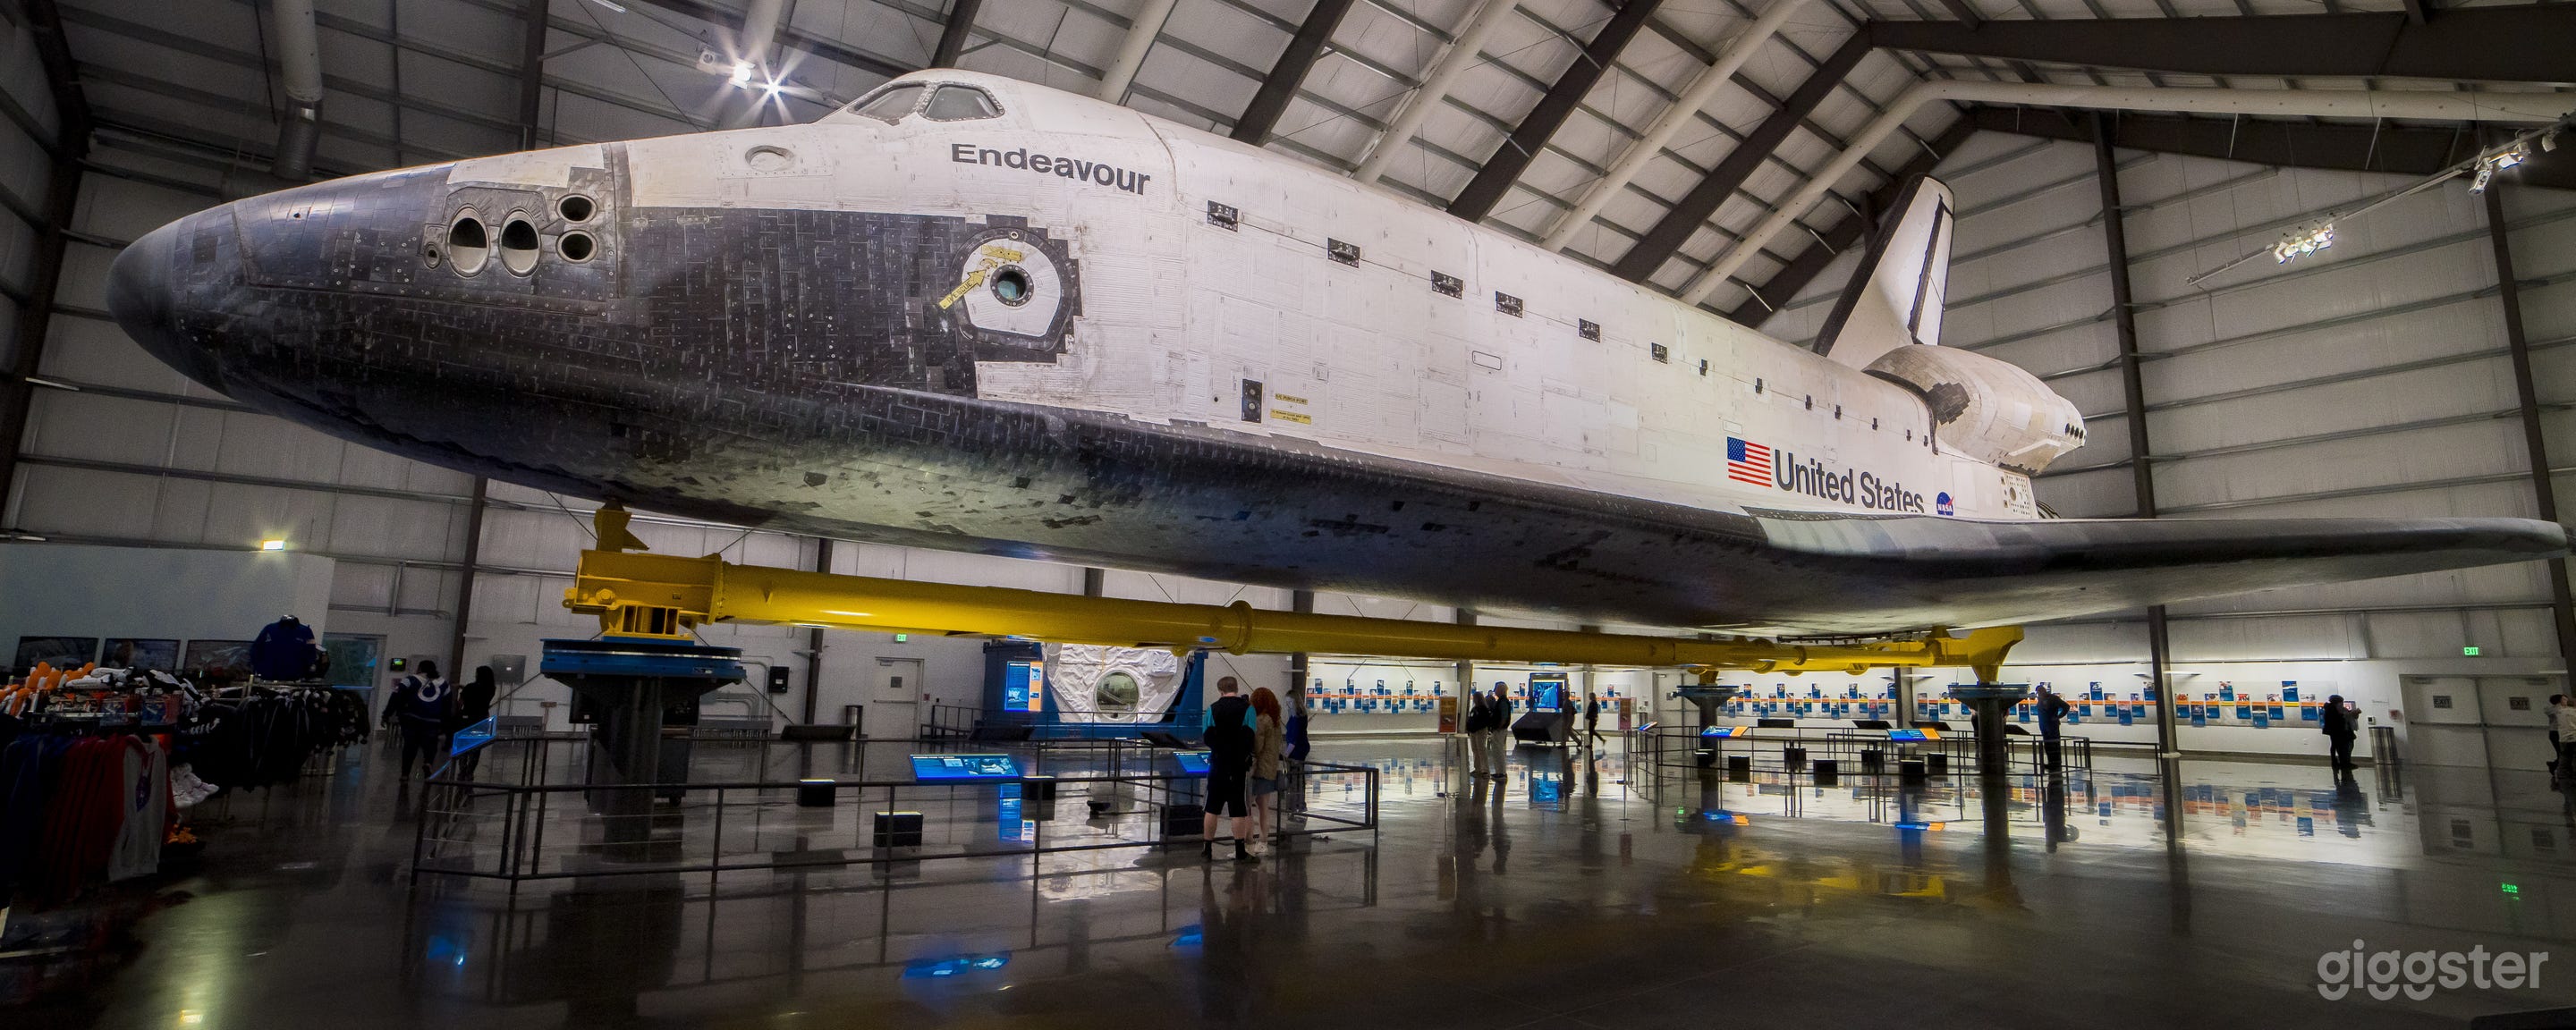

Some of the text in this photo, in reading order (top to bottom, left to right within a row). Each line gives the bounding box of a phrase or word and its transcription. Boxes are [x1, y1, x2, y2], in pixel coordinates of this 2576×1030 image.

[952, 143, 1151, 196] Endeavour
[1775, 449, 1925, 513] United States
[1937, 503, 1953, 512] NASA
[2463, 646, 2479, 655] EXIT
